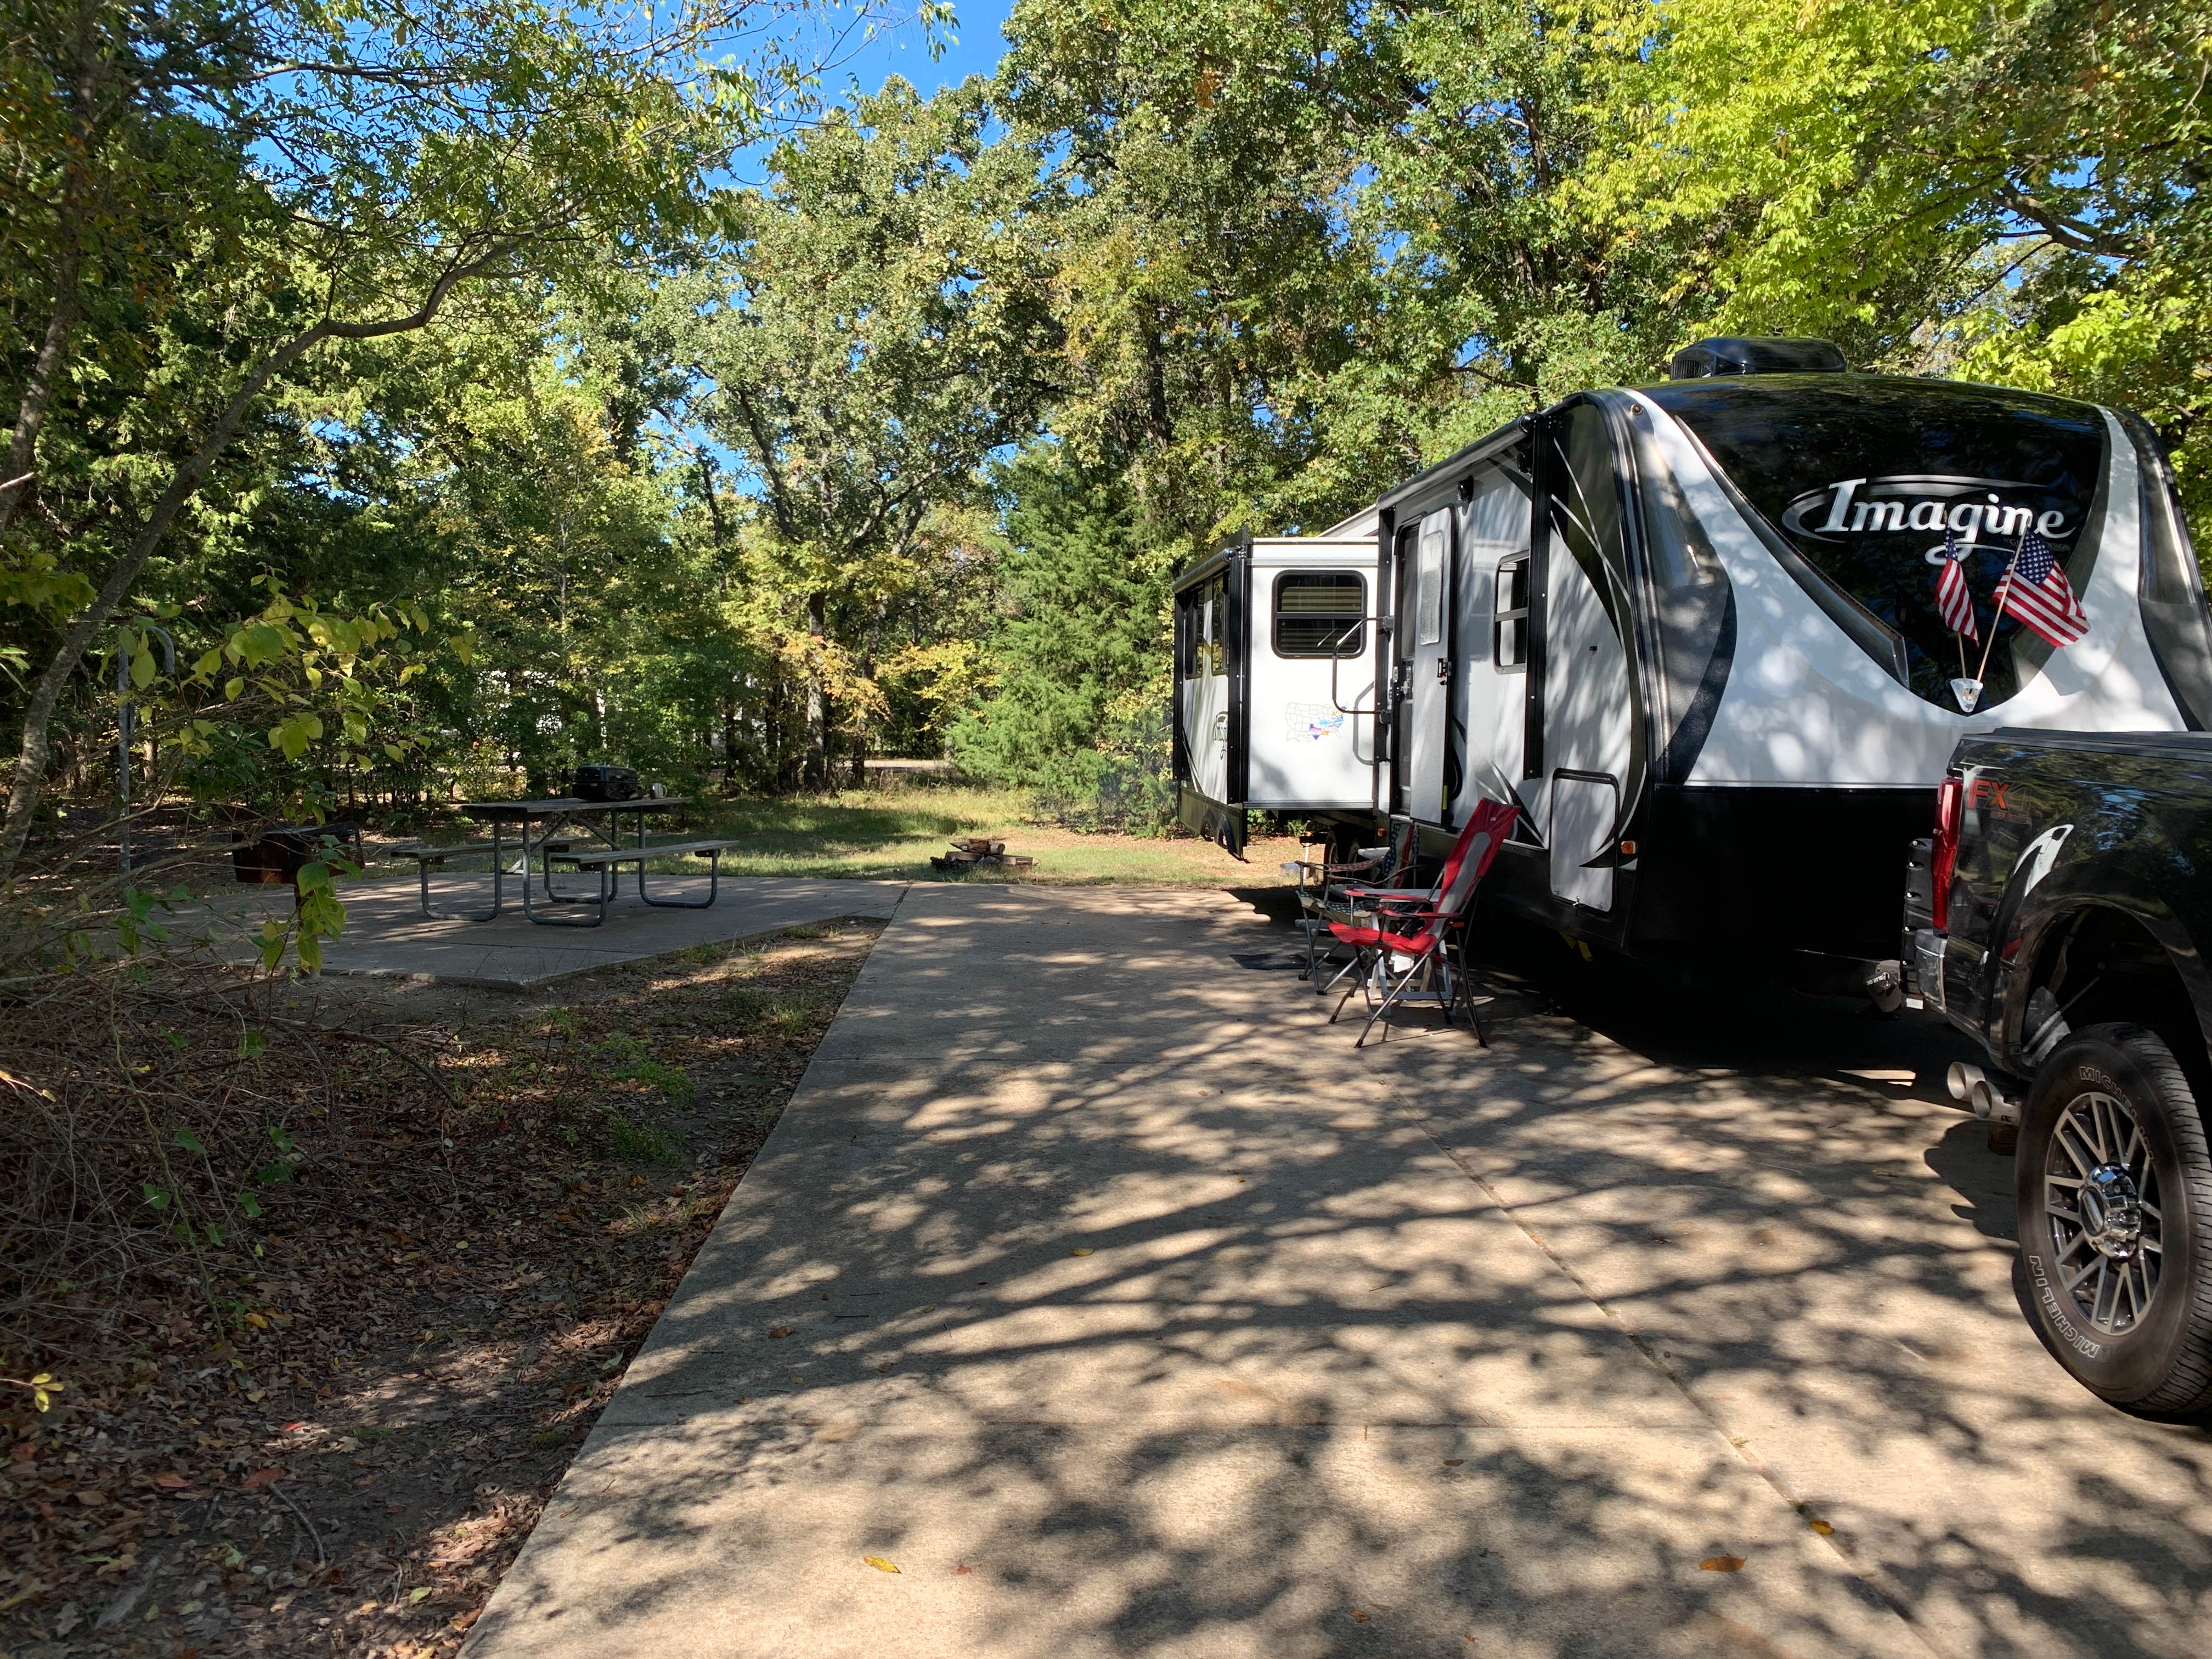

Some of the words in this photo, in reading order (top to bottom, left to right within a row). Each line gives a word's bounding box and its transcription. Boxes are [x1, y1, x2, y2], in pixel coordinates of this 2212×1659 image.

[1814, 478, 2076, 565] Imagine
[1966, 778, 2032, 812] FX4
[2029, 1255, 2100, 1358] MICHELIN
